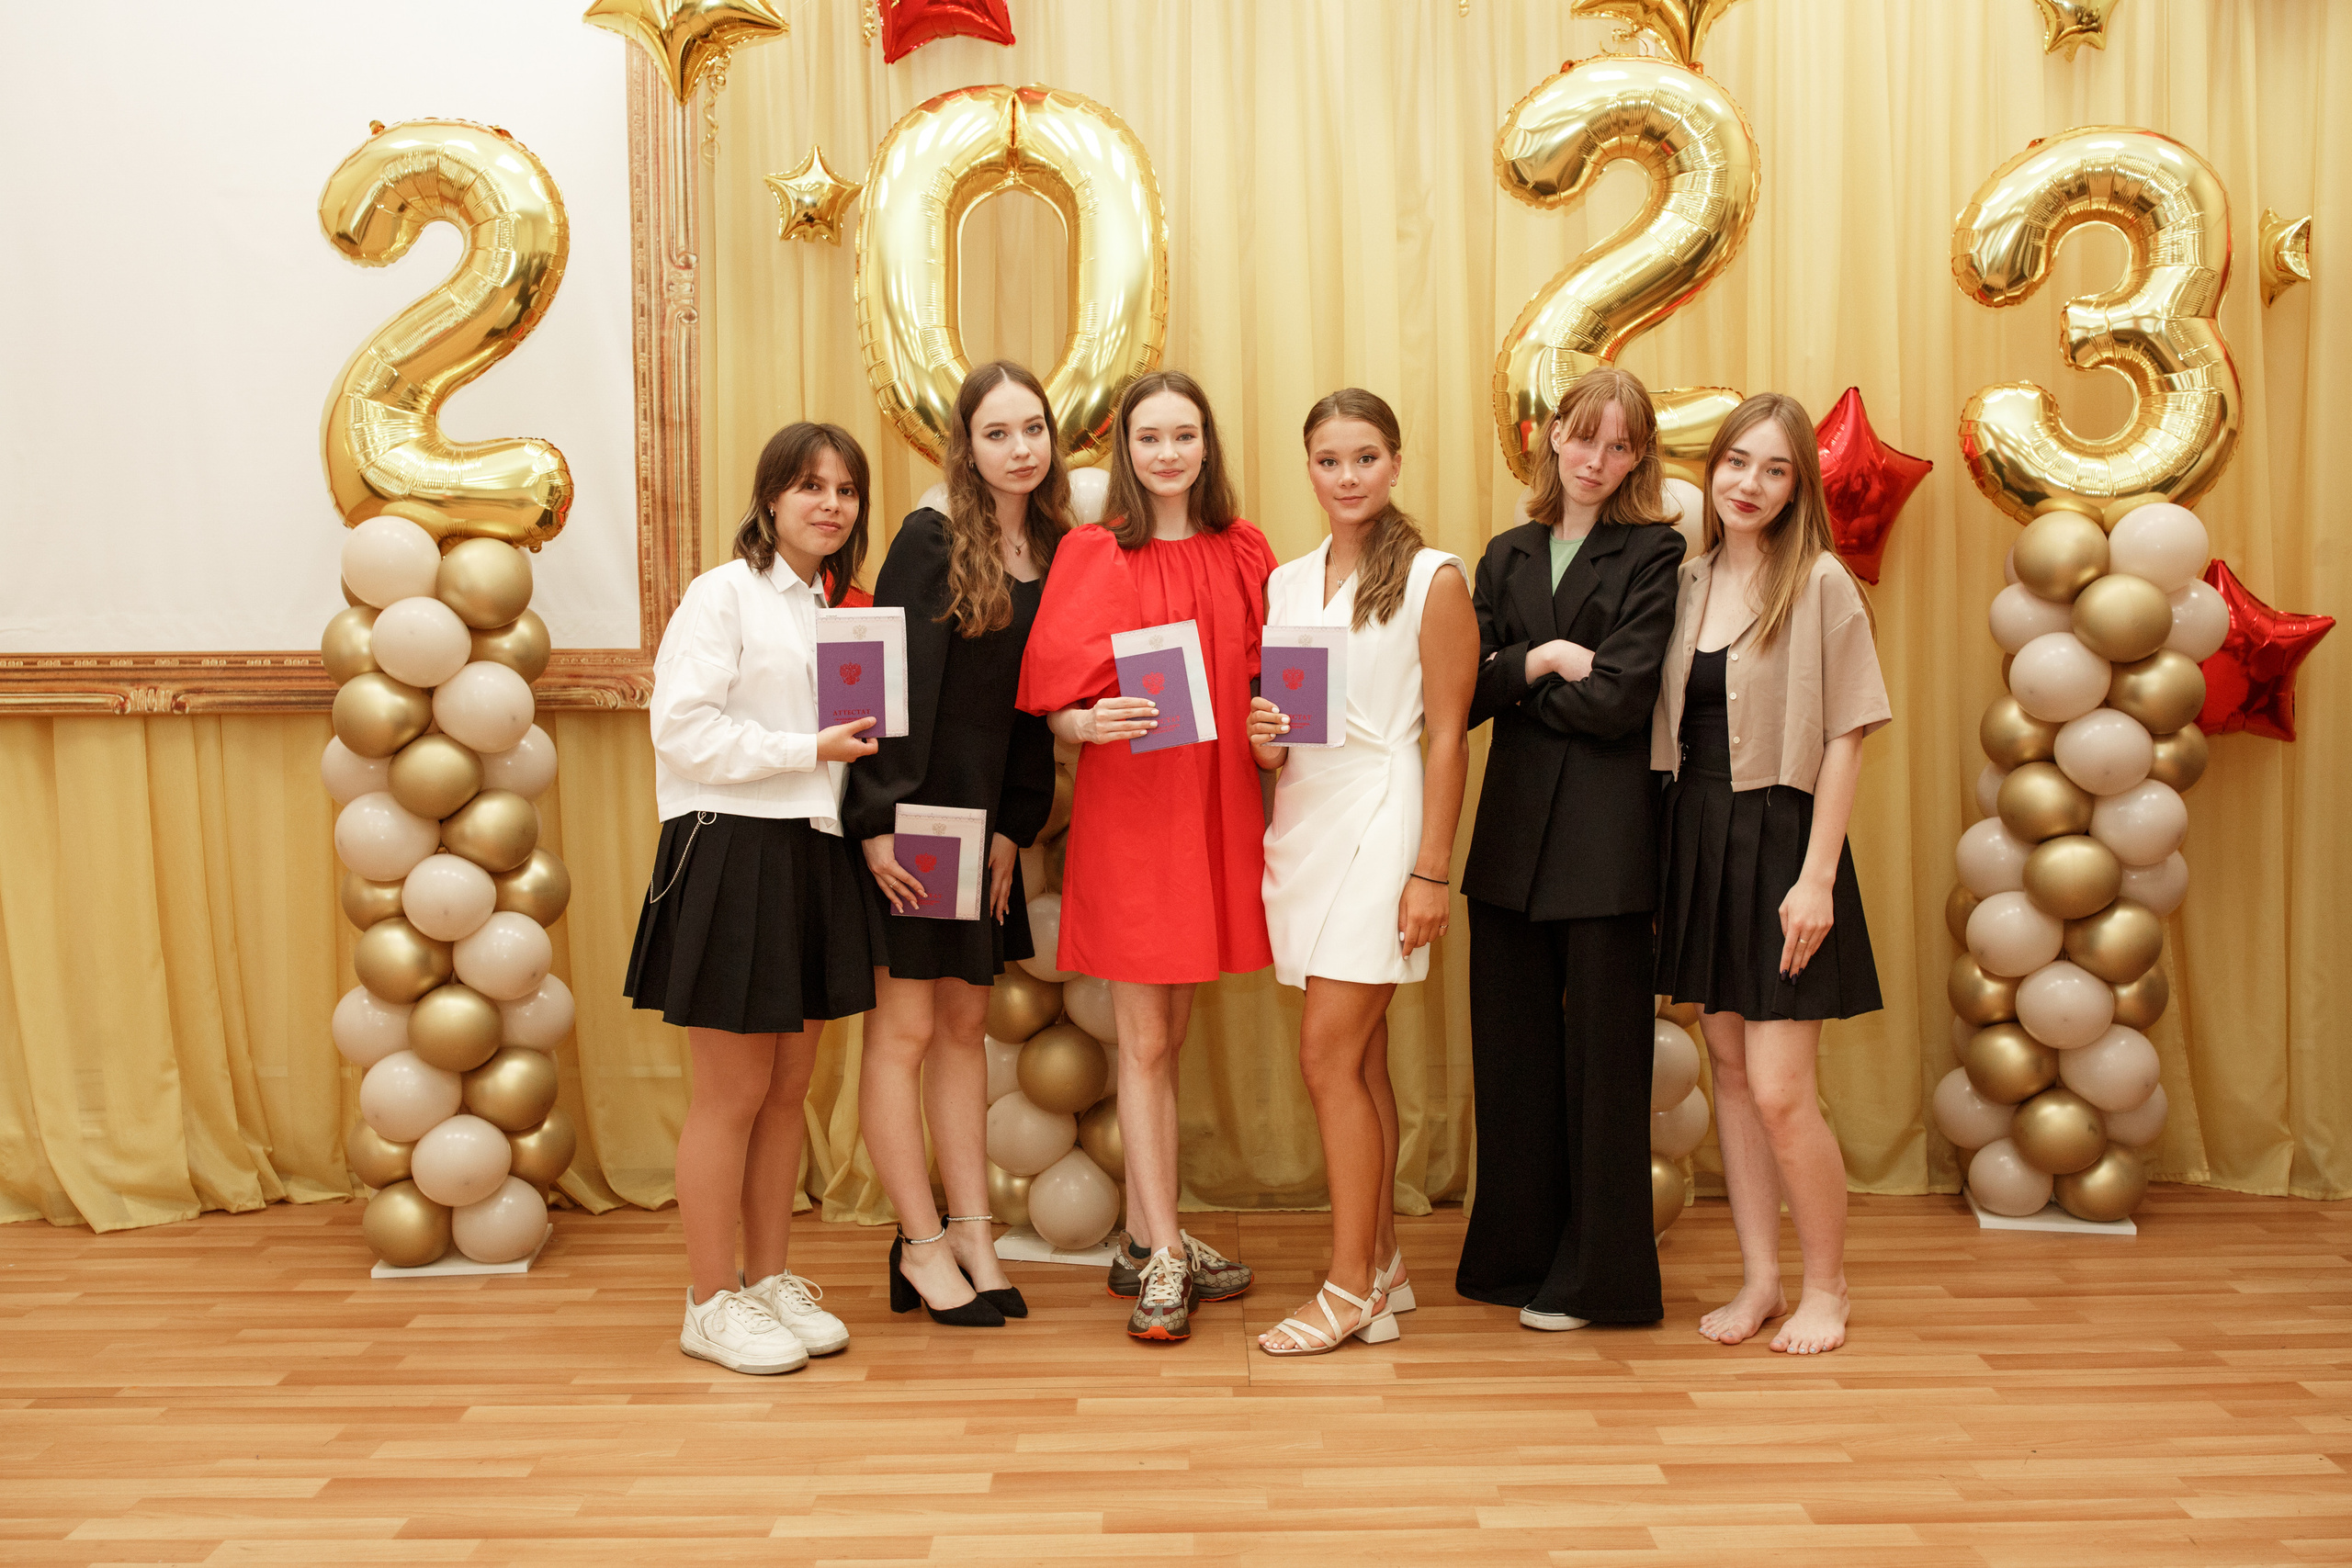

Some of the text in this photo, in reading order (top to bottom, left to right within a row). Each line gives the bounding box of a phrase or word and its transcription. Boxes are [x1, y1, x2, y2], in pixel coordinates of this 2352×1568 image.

[318, 55, 2245, 552] 2 0 2 3
